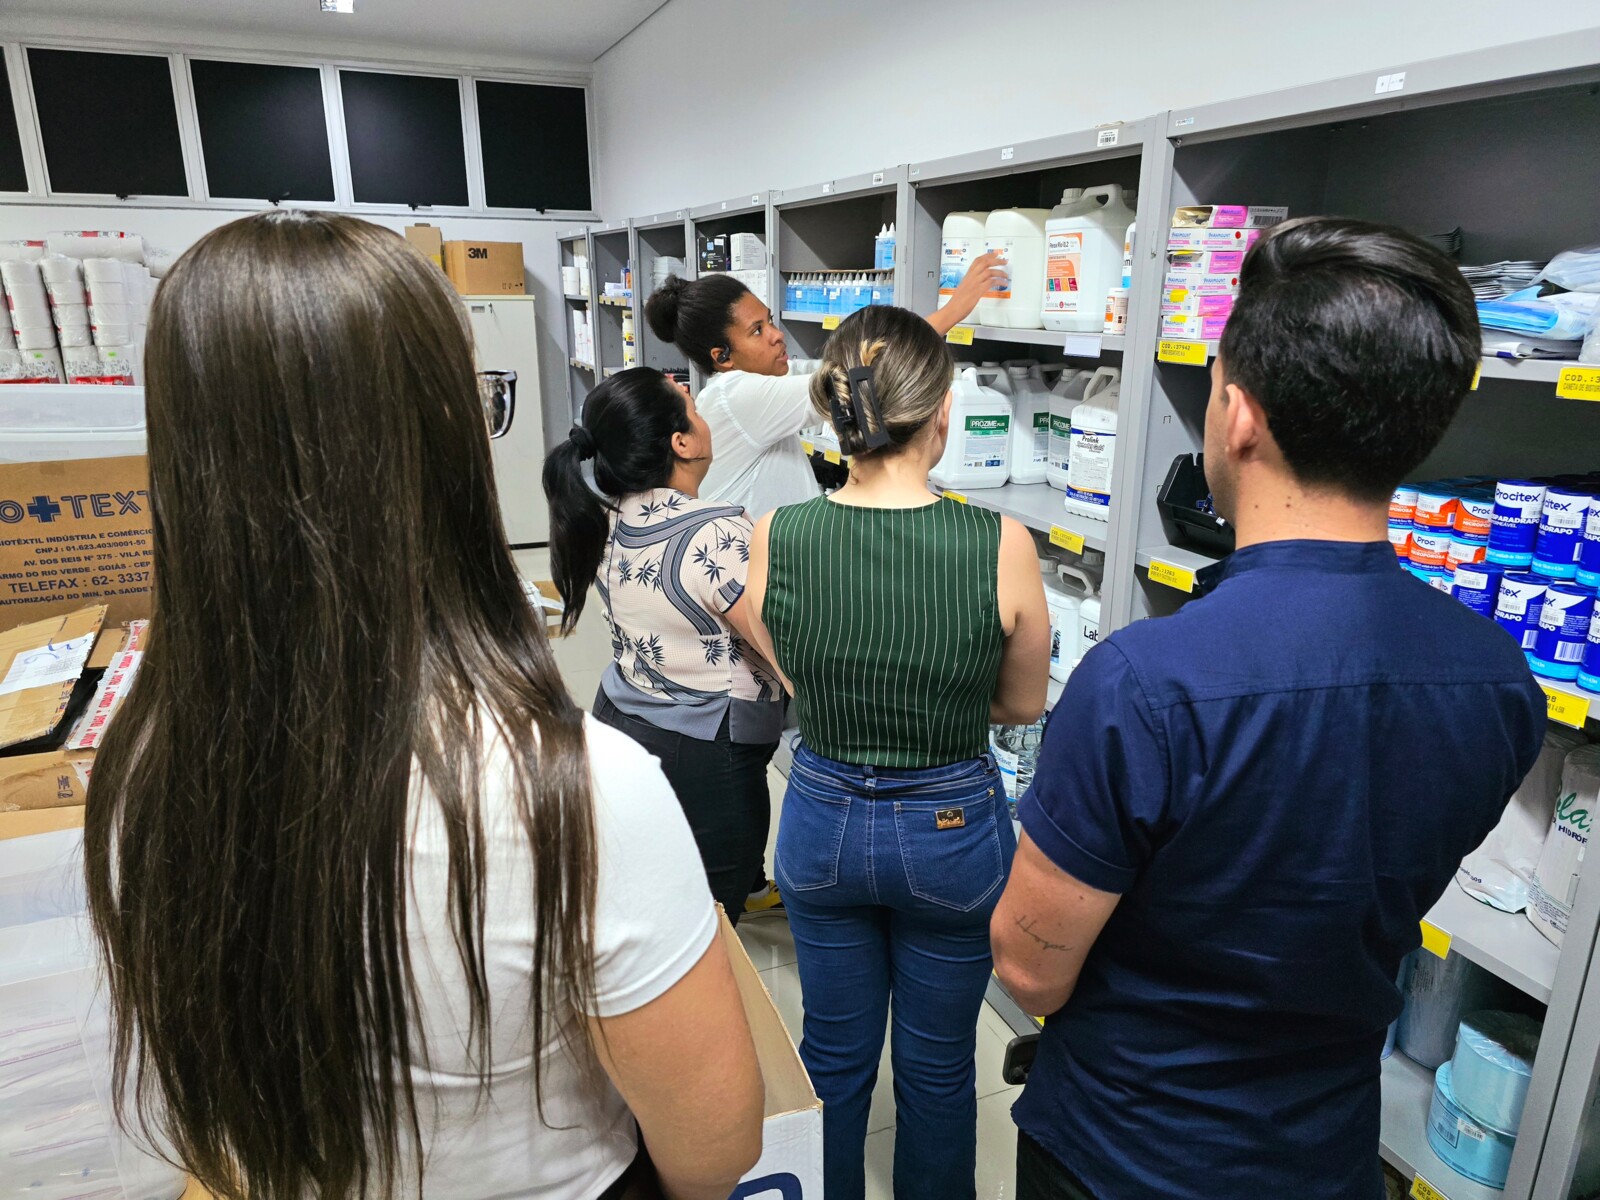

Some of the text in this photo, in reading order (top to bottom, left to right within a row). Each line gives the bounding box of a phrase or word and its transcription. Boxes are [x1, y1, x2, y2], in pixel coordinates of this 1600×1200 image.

[468, 248, 488, 259] 3M
[0, 537, 44, 547] IOTÊXTIL
[46, 533, 97, 544] INDÚSTRIA
[61, 556, 82, 564] REIS
[60, 567, 91, 575] VERDE
[98, 563, 127, 571] GOIÁS
[8, 578, 79, 593] TELEFAX
[117, 571, 150, 584] 3337
[82, 591, 103, 599] MIN.
[118, 586, 149, 595] SAÚDE
